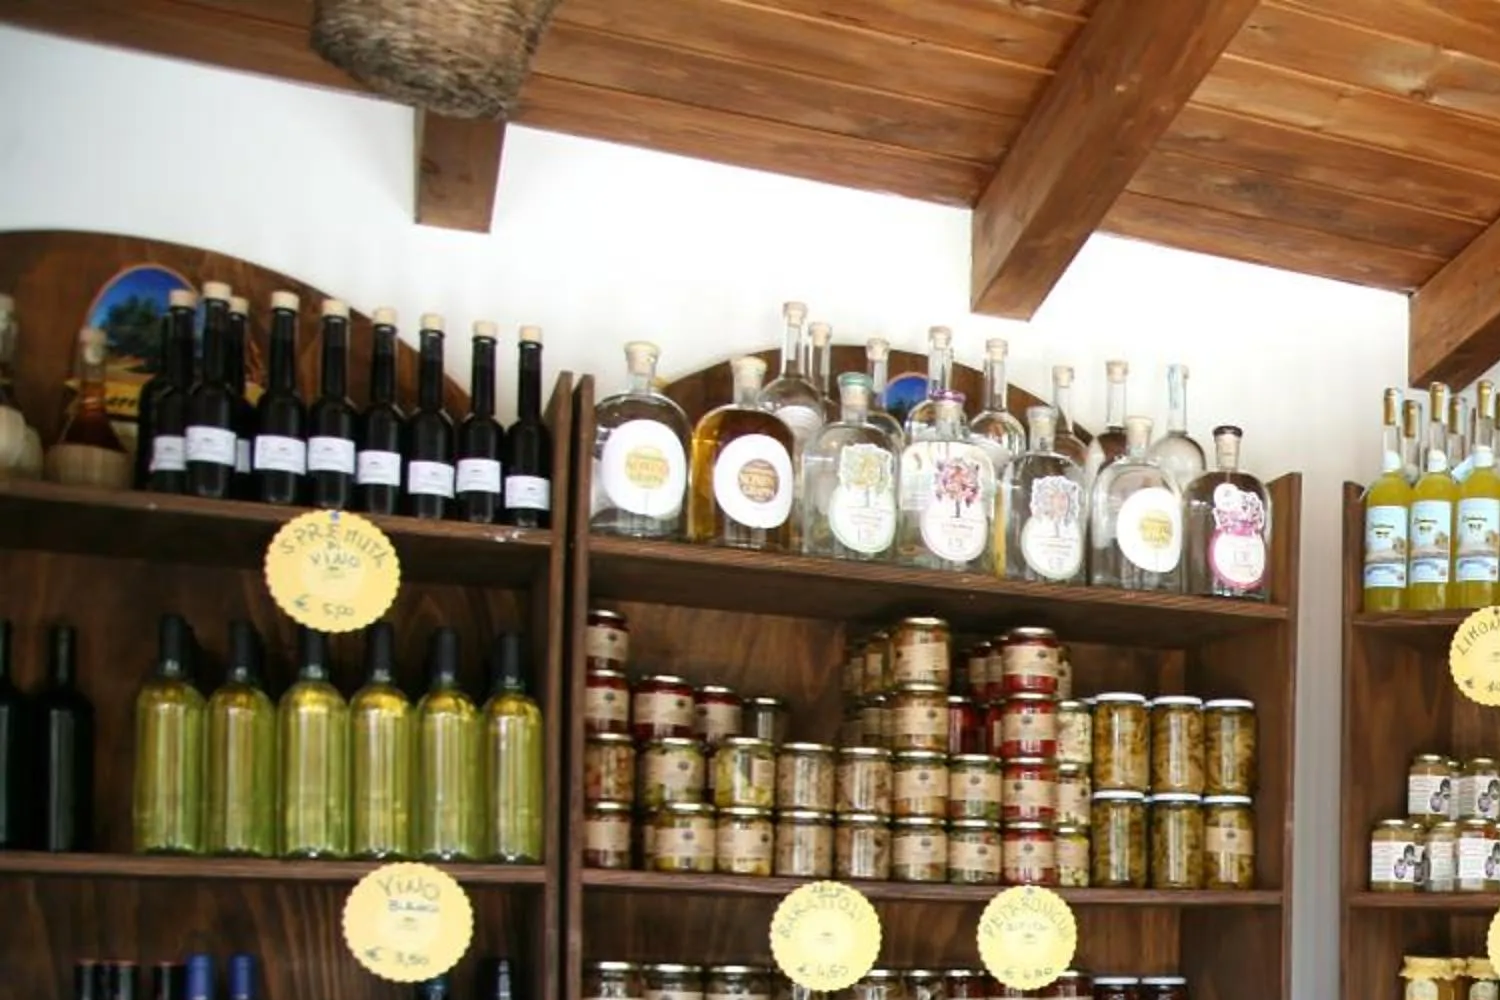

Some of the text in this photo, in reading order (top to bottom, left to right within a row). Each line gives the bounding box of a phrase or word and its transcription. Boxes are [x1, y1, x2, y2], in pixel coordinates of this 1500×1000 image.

[282, 522, 387, 569] SPREMUTA
[309, 552, 362, 570] VINO
[376, 874, 440, 901] VINO
